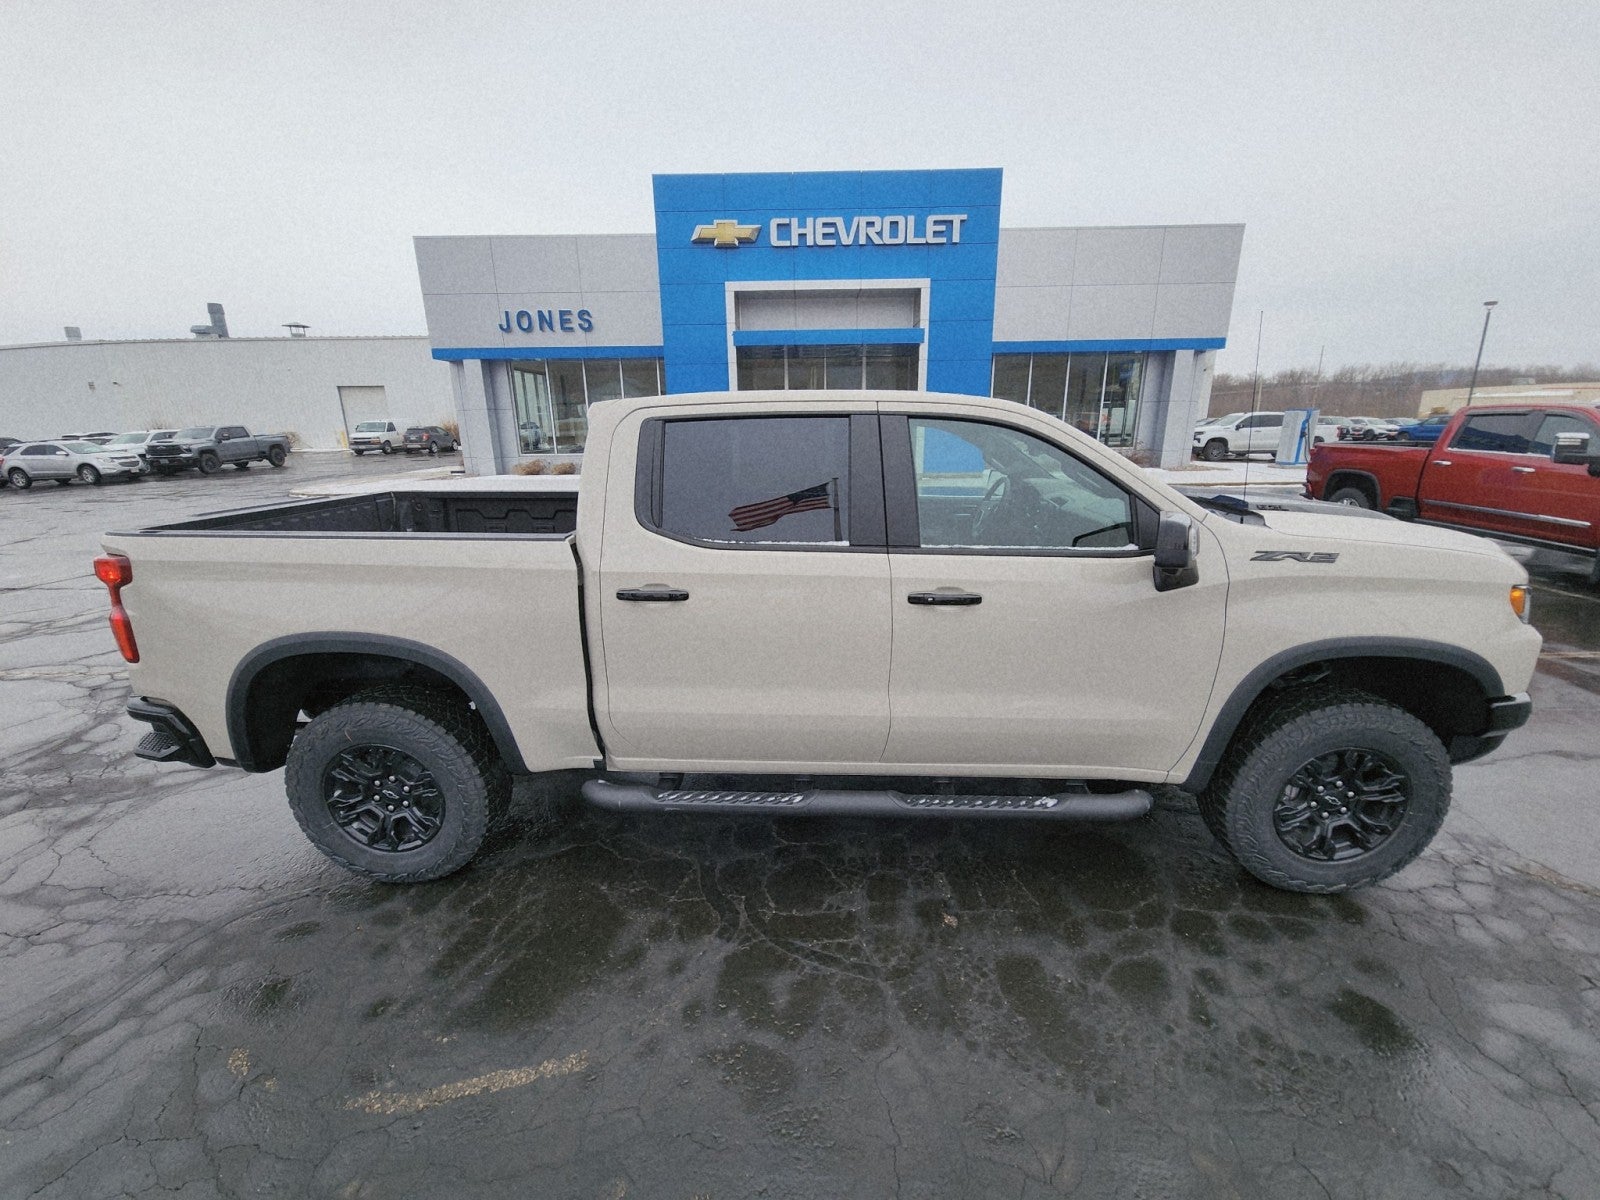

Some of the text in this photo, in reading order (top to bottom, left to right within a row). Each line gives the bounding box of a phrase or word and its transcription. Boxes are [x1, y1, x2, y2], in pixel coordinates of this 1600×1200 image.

[769, 214, 968, 248] CHEVROLET
[498, 309, 594, 334] JONES
[1249, 550, 1340, 564] ZR2
